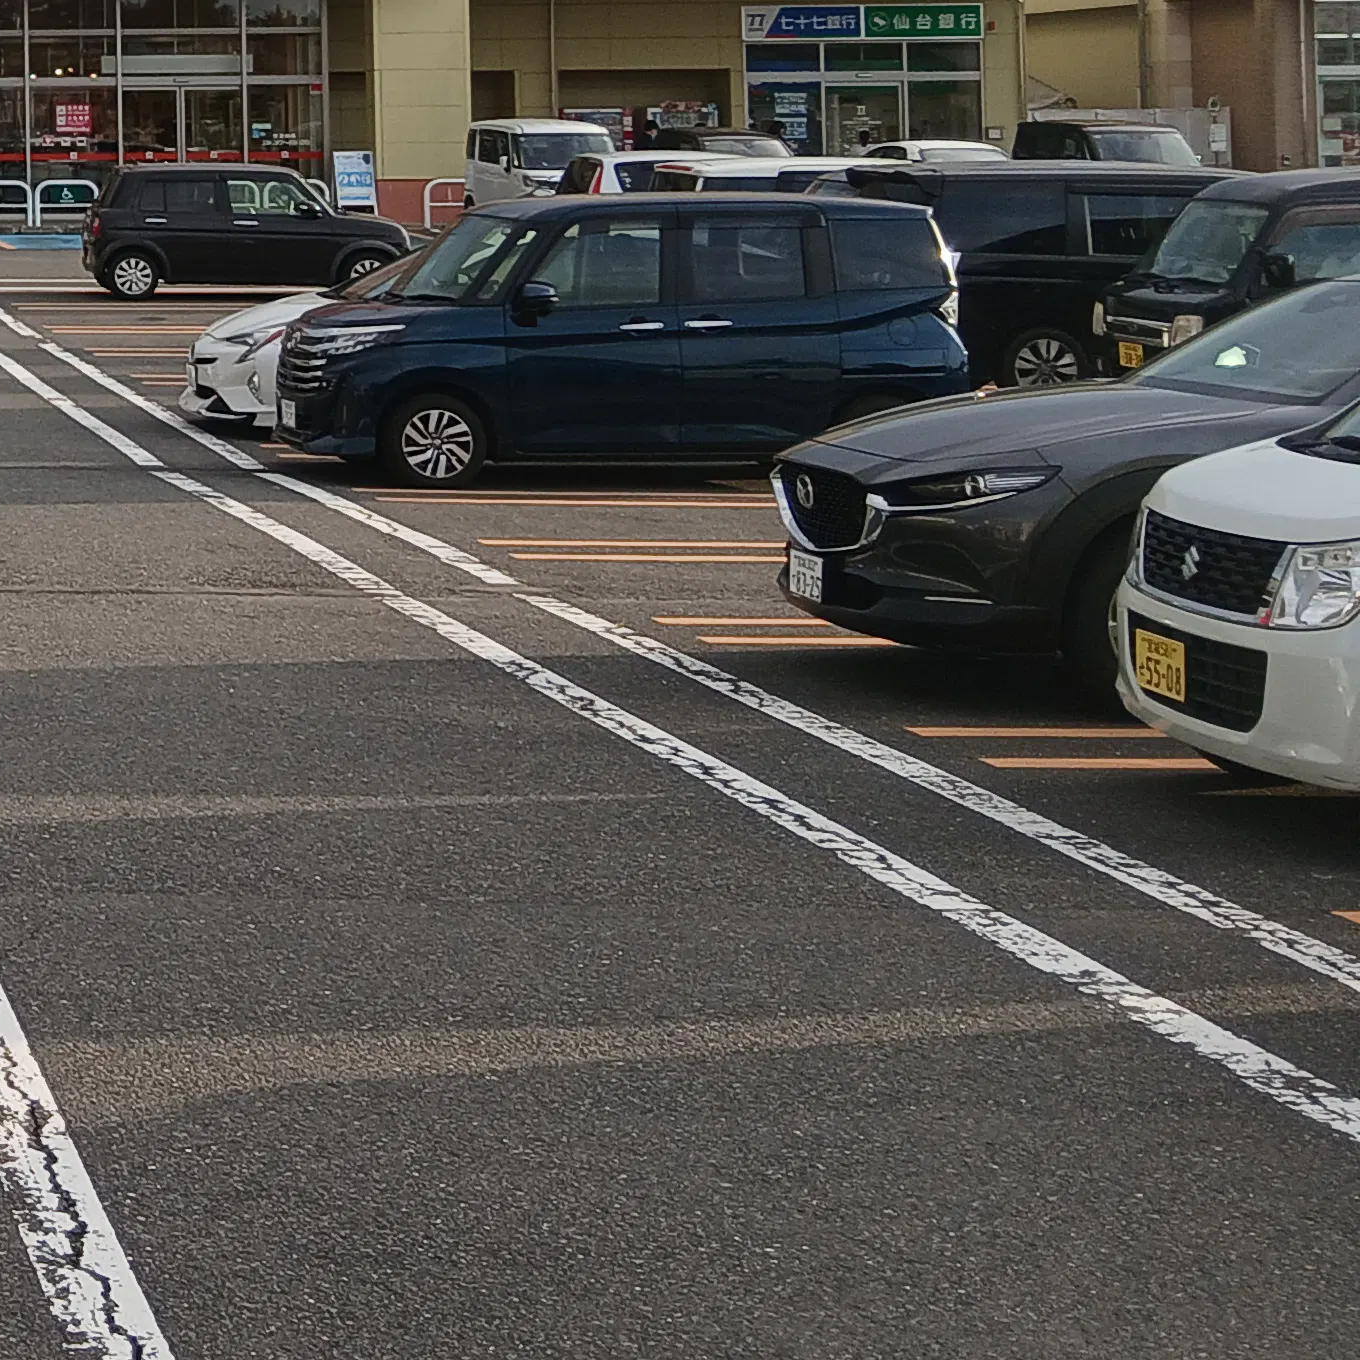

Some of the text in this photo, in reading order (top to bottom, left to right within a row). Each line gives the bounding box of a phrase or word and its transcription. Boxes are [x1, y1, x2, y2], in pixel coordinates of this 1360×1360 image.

[780, 14, 857, 30] 七十七銀行
[893, 13, 978, 30] 仙台銀行
[1145, 655, 1182, 696] 55-08
